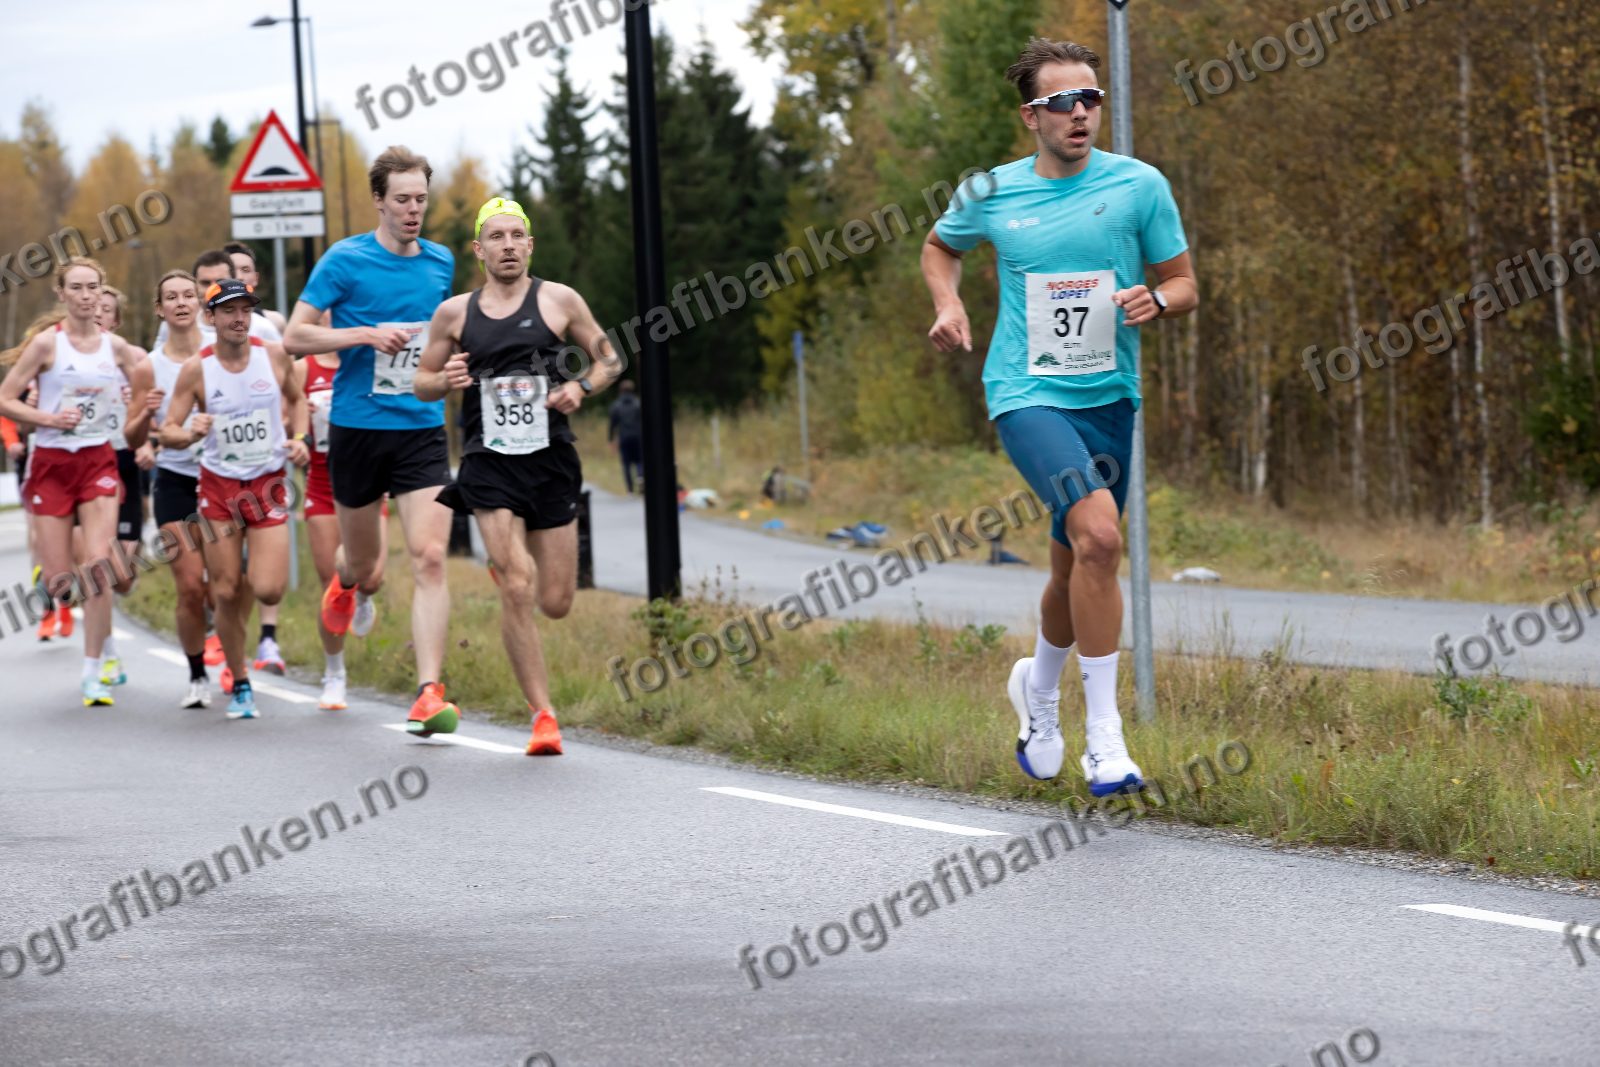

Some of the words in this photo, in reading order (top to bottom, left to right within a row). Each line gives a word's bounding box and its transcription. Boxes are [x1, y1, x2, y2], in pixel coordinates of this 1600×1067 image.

[1043, 278, 1099, 291] NORGES
[1054, 306, 1089, 338] 37
[495, 402, 534, 426] 358
[221, 420, 267, 444] 1006
